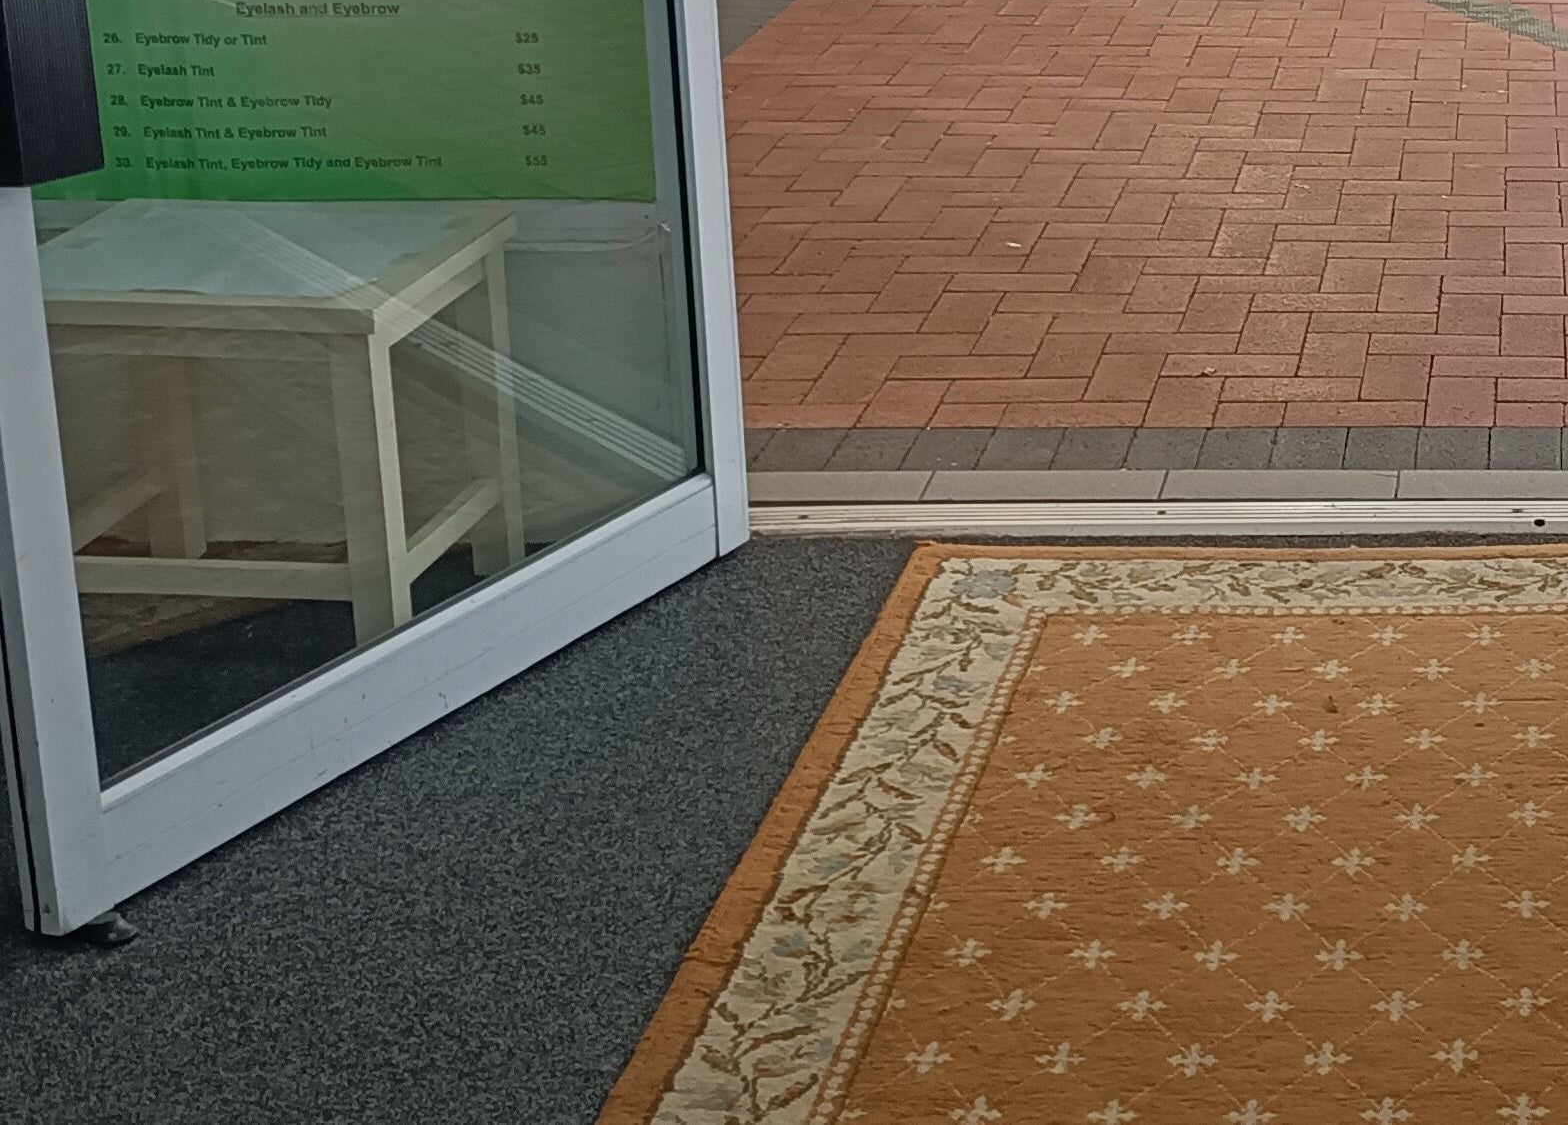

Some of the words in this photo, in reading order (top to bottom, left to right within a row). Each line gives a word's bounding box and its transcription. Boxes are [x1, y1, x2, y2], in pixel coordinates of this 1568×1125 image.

[235, 1, 295, 17] Eyelash
[300, 1, 328, 15] and
[332, 1, 400, 17] Eyebrow
[135, 33, 190, 47] Eyebrow
[194, 33, 220, 48] Tidy
[241, 33, 268, 46] Tint
[138, 63, 188, 78] Eyelash
[190, 63, 215, 77] Tint
[140, 95, 195, 109] Eyebrow
[198, 95, 224, 107] Tint
[241, 94, 300, 109] Eyebrow
[303, 94, 332, 109] Tidy
[143, 125, 193, 140] Eyelash
[196, 126, 221, 138] Tint
[238, 125, 297, 140] Eyebrow
[301, 125, 328, 138] Tint
[145, 156, 195, 171] Eyelash
[231, 155, 289, 171] Eyebrow
[293, 155, 322, 171] Tidy
[327, 156, 351, 168] and
[354, 155, 412, 171] Eyebrow
[416, 154, 443, 167] Tint
